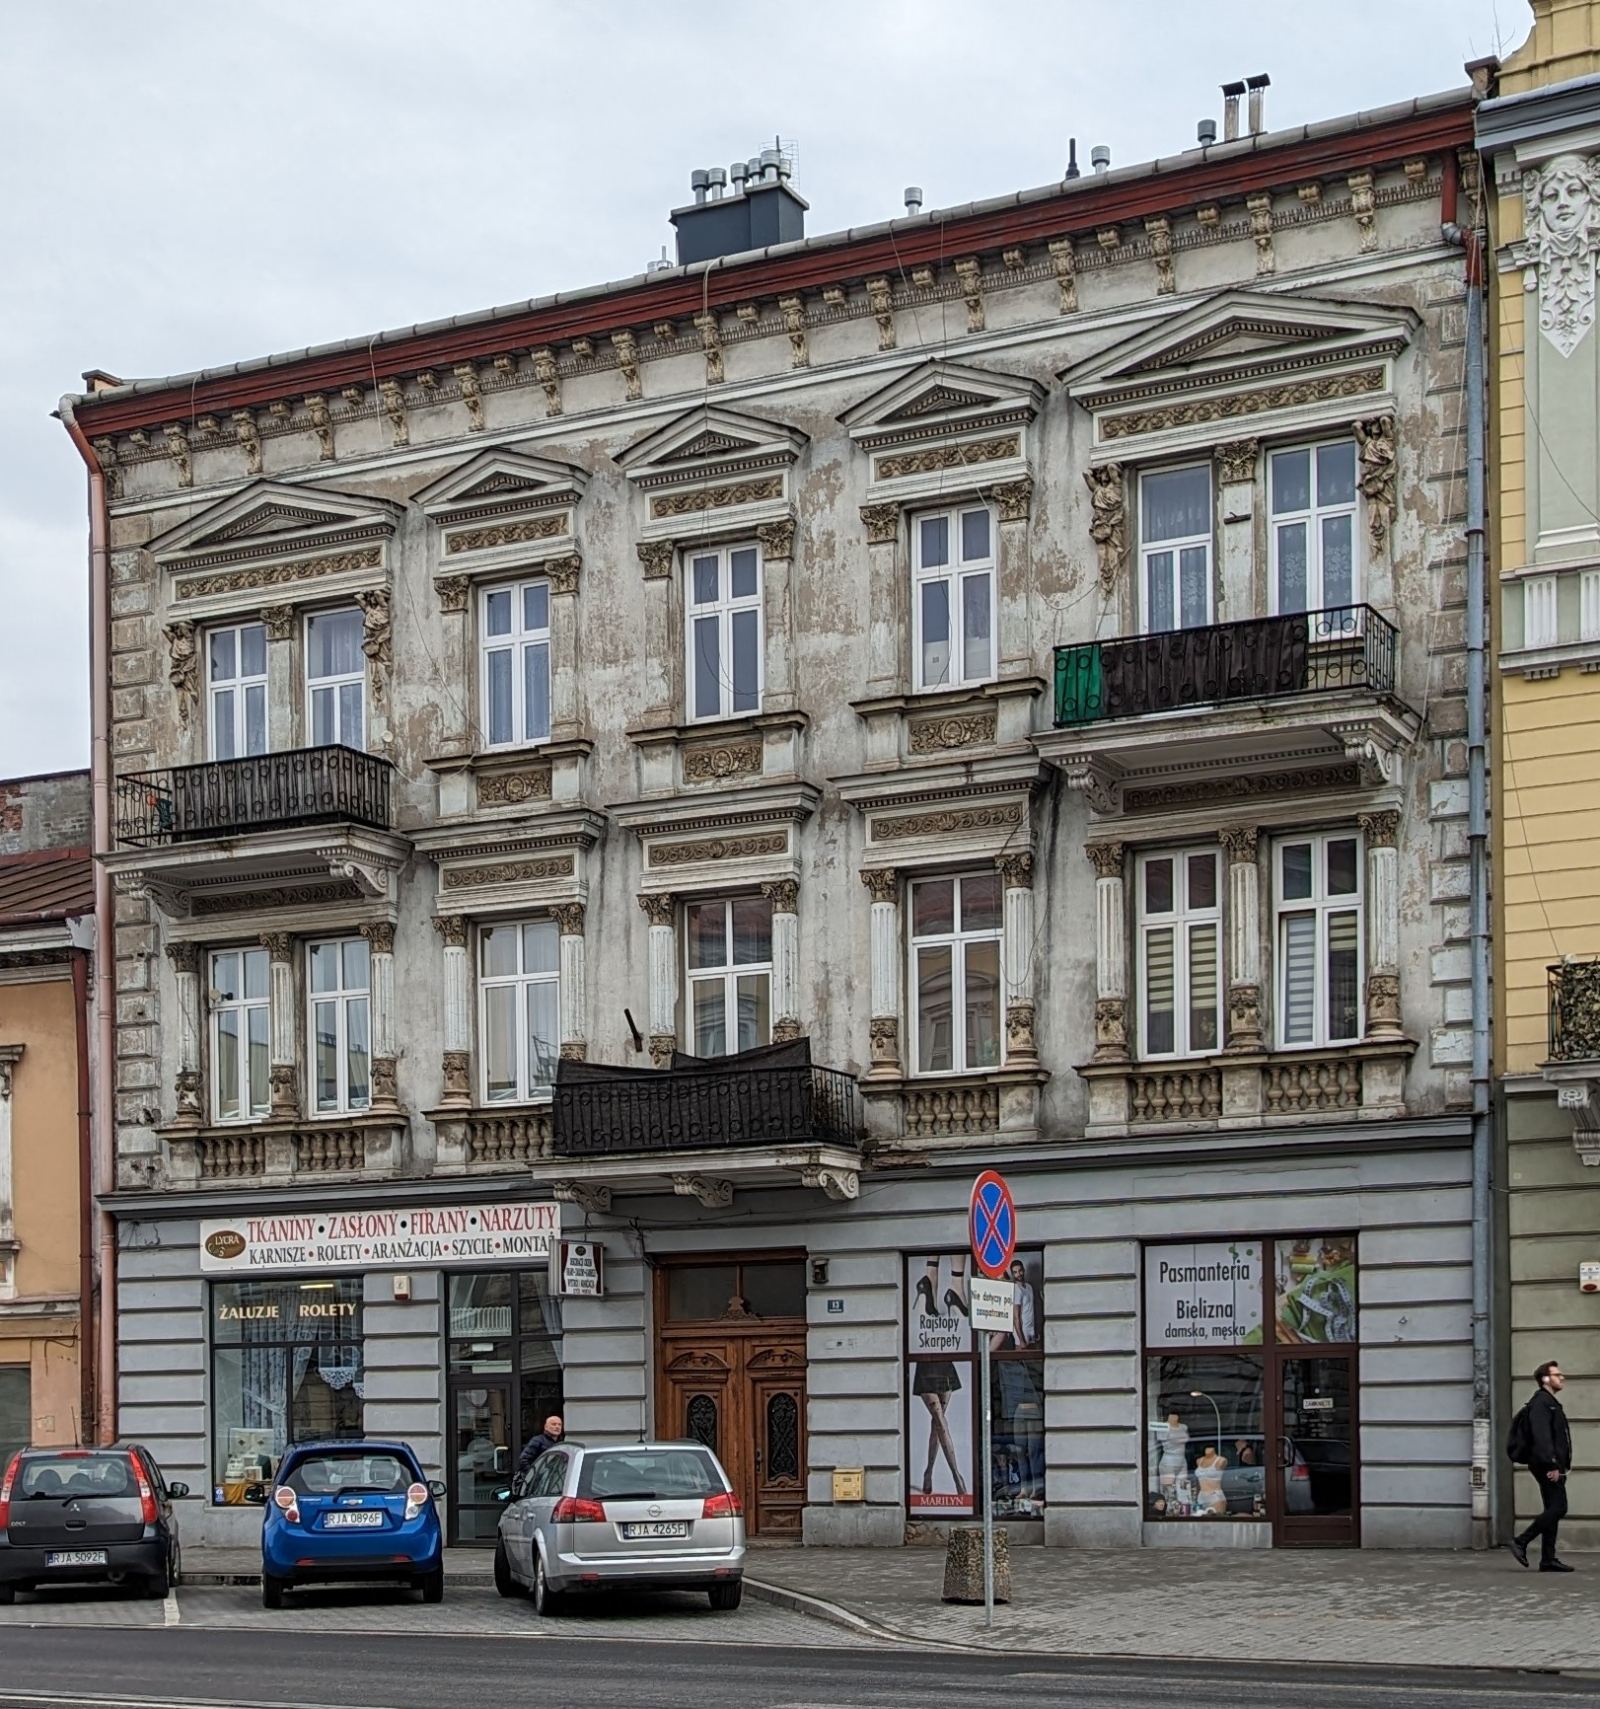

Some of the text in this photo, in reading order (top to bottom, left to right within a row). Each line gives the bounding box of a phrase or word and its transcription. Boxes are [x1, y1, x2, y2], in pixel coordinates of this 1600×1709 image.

[248, 1206, 557, 1243] TKANINY ZASŁONY FIRANY NARZUTY
[250, 1247, 306, 1264] KARNISZE
[317, 1244, 362, 1262] ROLETY
[371, 1238, 443, 1260] ARANŻACJA
[452, 1238, 493, 1256] SZYCIE
[1160, 1259, 1250, 1283] Pasmanteria
[219, 1303, 356, 1320] ŻALUZJE ROLETY
[1177, 1297, 1233, 1319] Bielizna
[919, 1314, 960, 1332] Rajstopy
[1165, 1322, 1246, 1340] damska, męska
[919, 1332, 961, 1350] Skarpety
[920, 1496, 964, 1506] MARILYN
[328, 1512, 380, 1524] RJA 0896F
[629, 1523, 683, 1535] RJA 4265F
[53, 1551, 104, 1563] RJA 5092F
